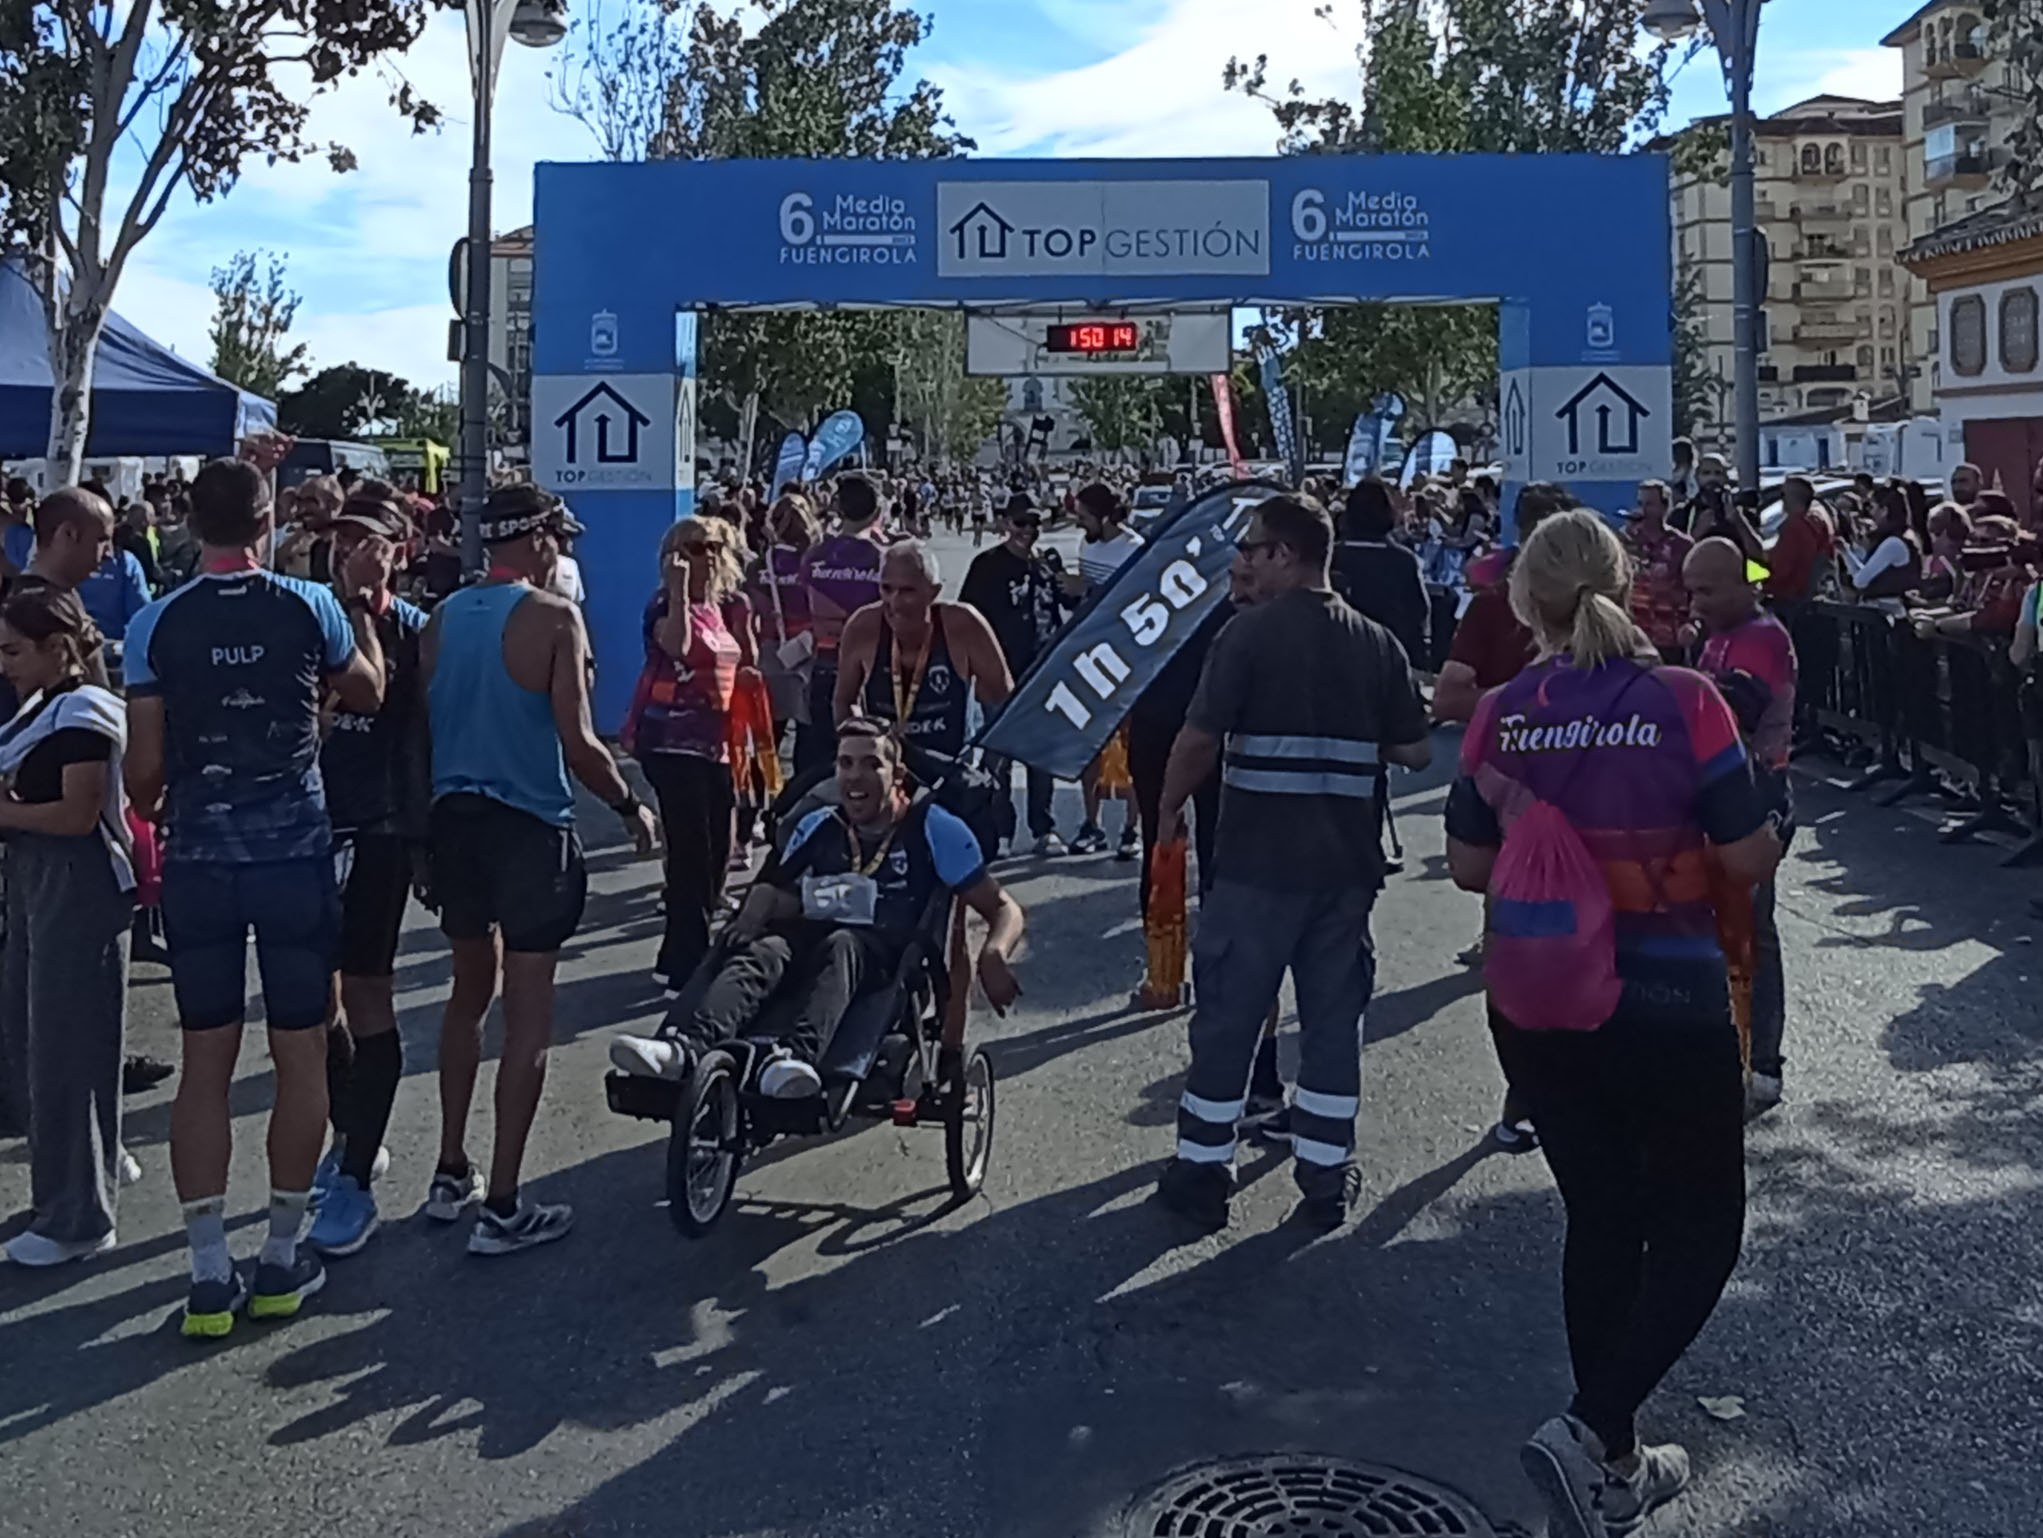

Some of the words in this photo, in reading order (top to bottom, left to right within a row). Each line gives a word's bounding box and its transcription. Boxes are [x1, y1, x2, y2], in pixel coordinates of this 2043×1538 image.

[836, 194, 905, 215] Media
[1347, 190, 1417, 211] Media
[822, 210, 916, 231] Maratón
[1335, 207, 1429, 227] Maratón
[1022, 229, 1096, 257] TOP
[1105, 221, 1259, 258] GESTIÓN
[780, 246, 917, 264] FUENGIROLA
[1293, 243, 1429, 261] FUENGIROLA
[556, 471, 586, 483] TOP
[1557, 461, 1586, 475] TOP
[212, 646, 264, 665] PULP
[1500, 713, 1660, 752] Fuengirola
